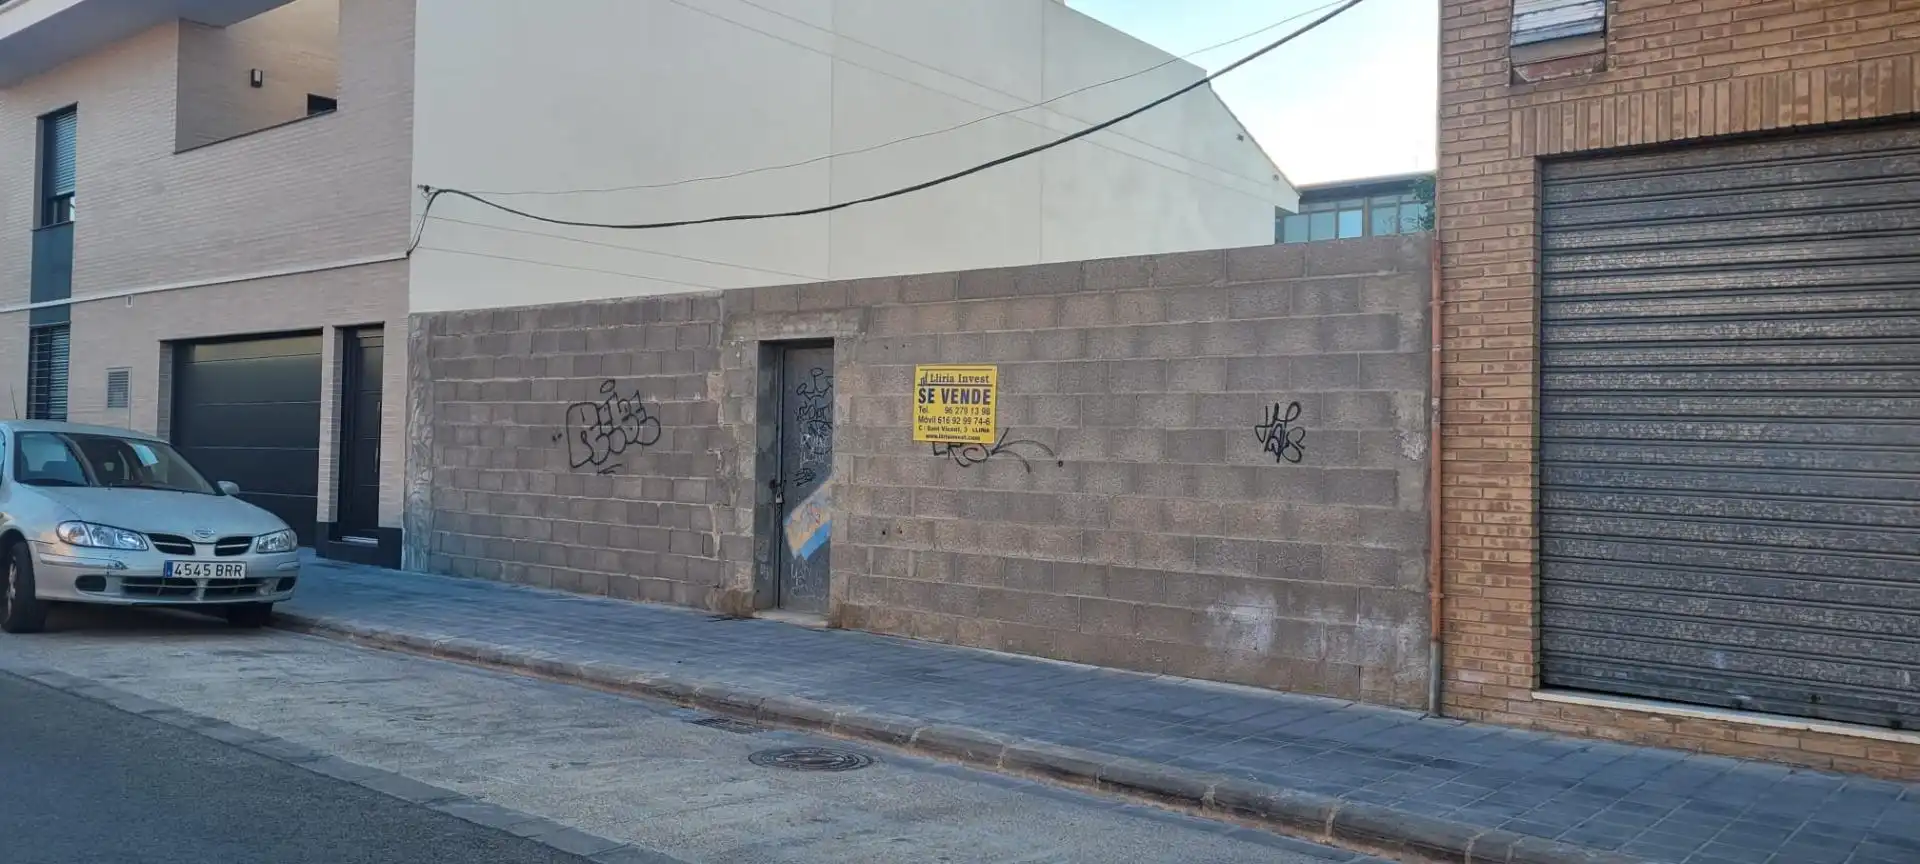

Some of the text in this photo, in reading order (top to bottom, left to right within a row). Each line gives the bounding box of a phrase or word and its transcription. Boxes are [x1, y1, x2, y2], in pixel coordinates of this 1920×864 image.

[958, 373, 989, 383] Invest
[918, 387, 991, 405] SE VENDE
[971, 407, 979, 415] 13
[937, 416, 951, 424] 616
[974, 417, 991, 425] 74-6
[174, 563, 242, 577] 4545 BRR
